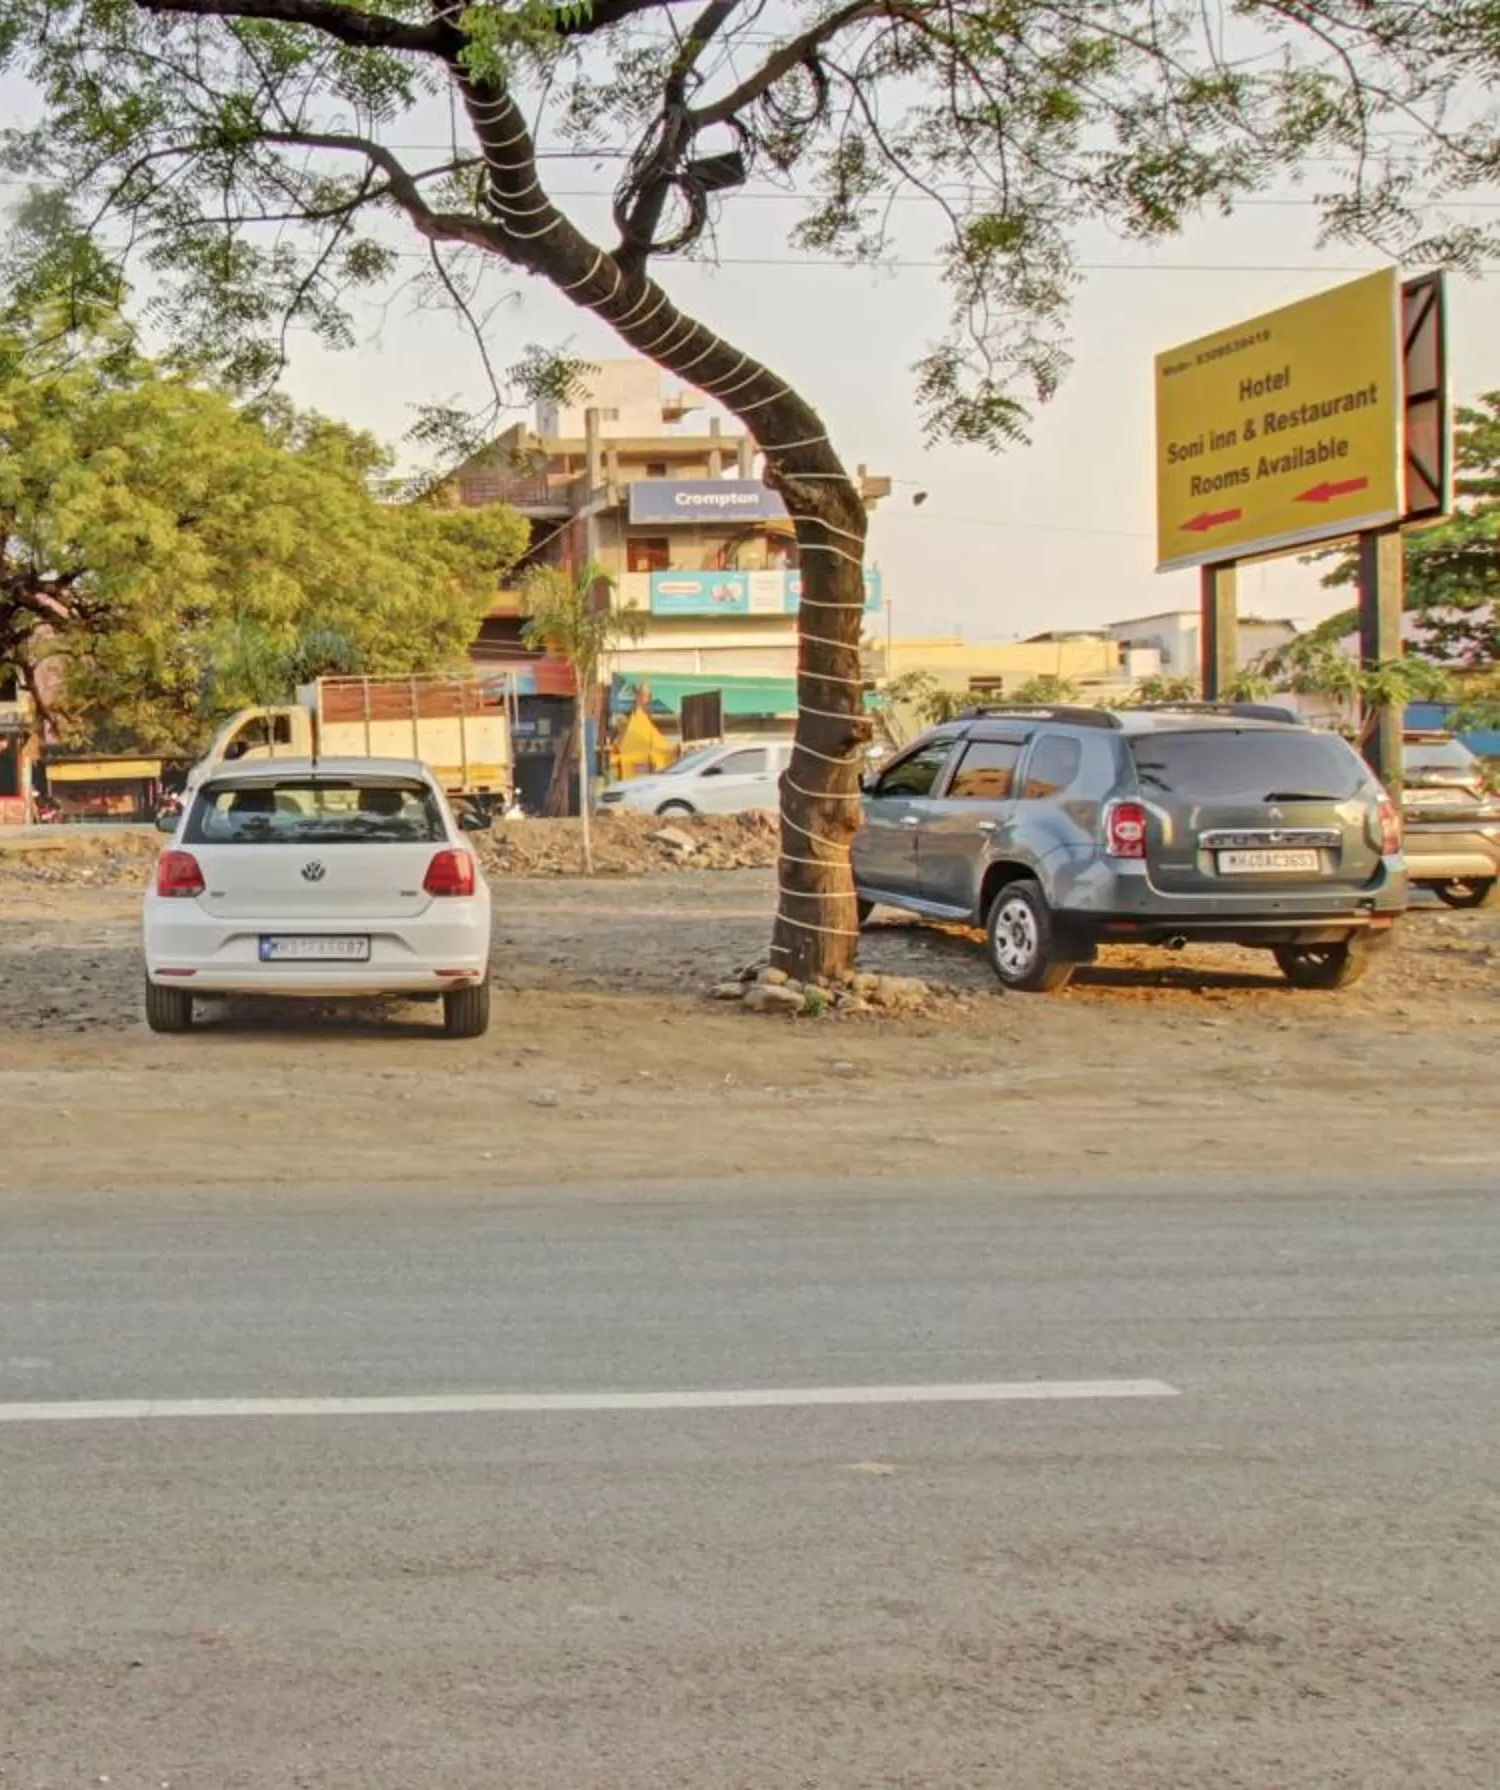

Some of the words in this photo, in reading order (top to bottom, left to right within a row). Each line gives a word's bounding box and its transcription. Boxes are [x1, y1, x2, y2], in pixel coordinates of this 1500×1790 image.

[1239, 363, 1290, 402] Hotel
[1167, 433, 1205, 464] Soni
[1209, 430, 1237, 451] inn
[1243, 418, 1257, 443] &
[1263, 383, 1379, 436] Restaurant
[1190, 465, 1250, 497] Rooms
[1256, 436, 1349, 480] Available
[674, 492, 760, 508] Crompton
